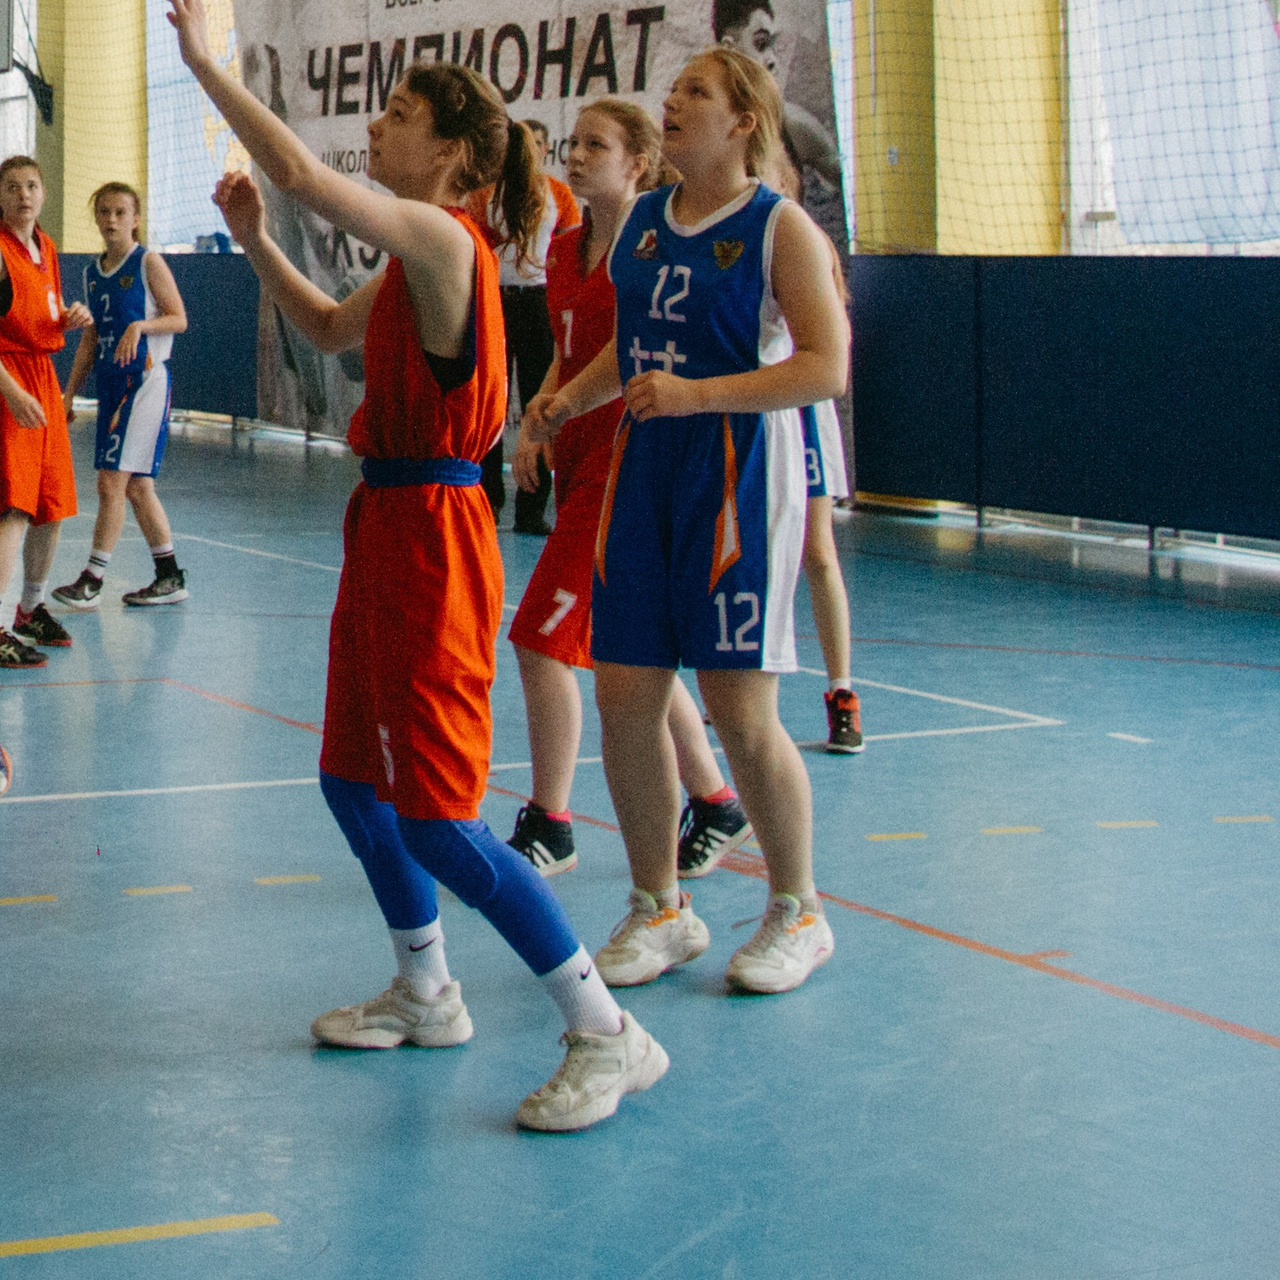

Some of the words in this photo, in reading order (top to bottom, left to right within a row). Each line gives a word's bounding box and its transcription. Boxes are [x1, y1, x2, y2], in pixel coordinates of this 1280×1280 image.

[648, 265, 692, 323] 12
[104, 433, 121, 464] 2
[538, 587, 578, 637] 7
[713, 591, 761, 652] 12
